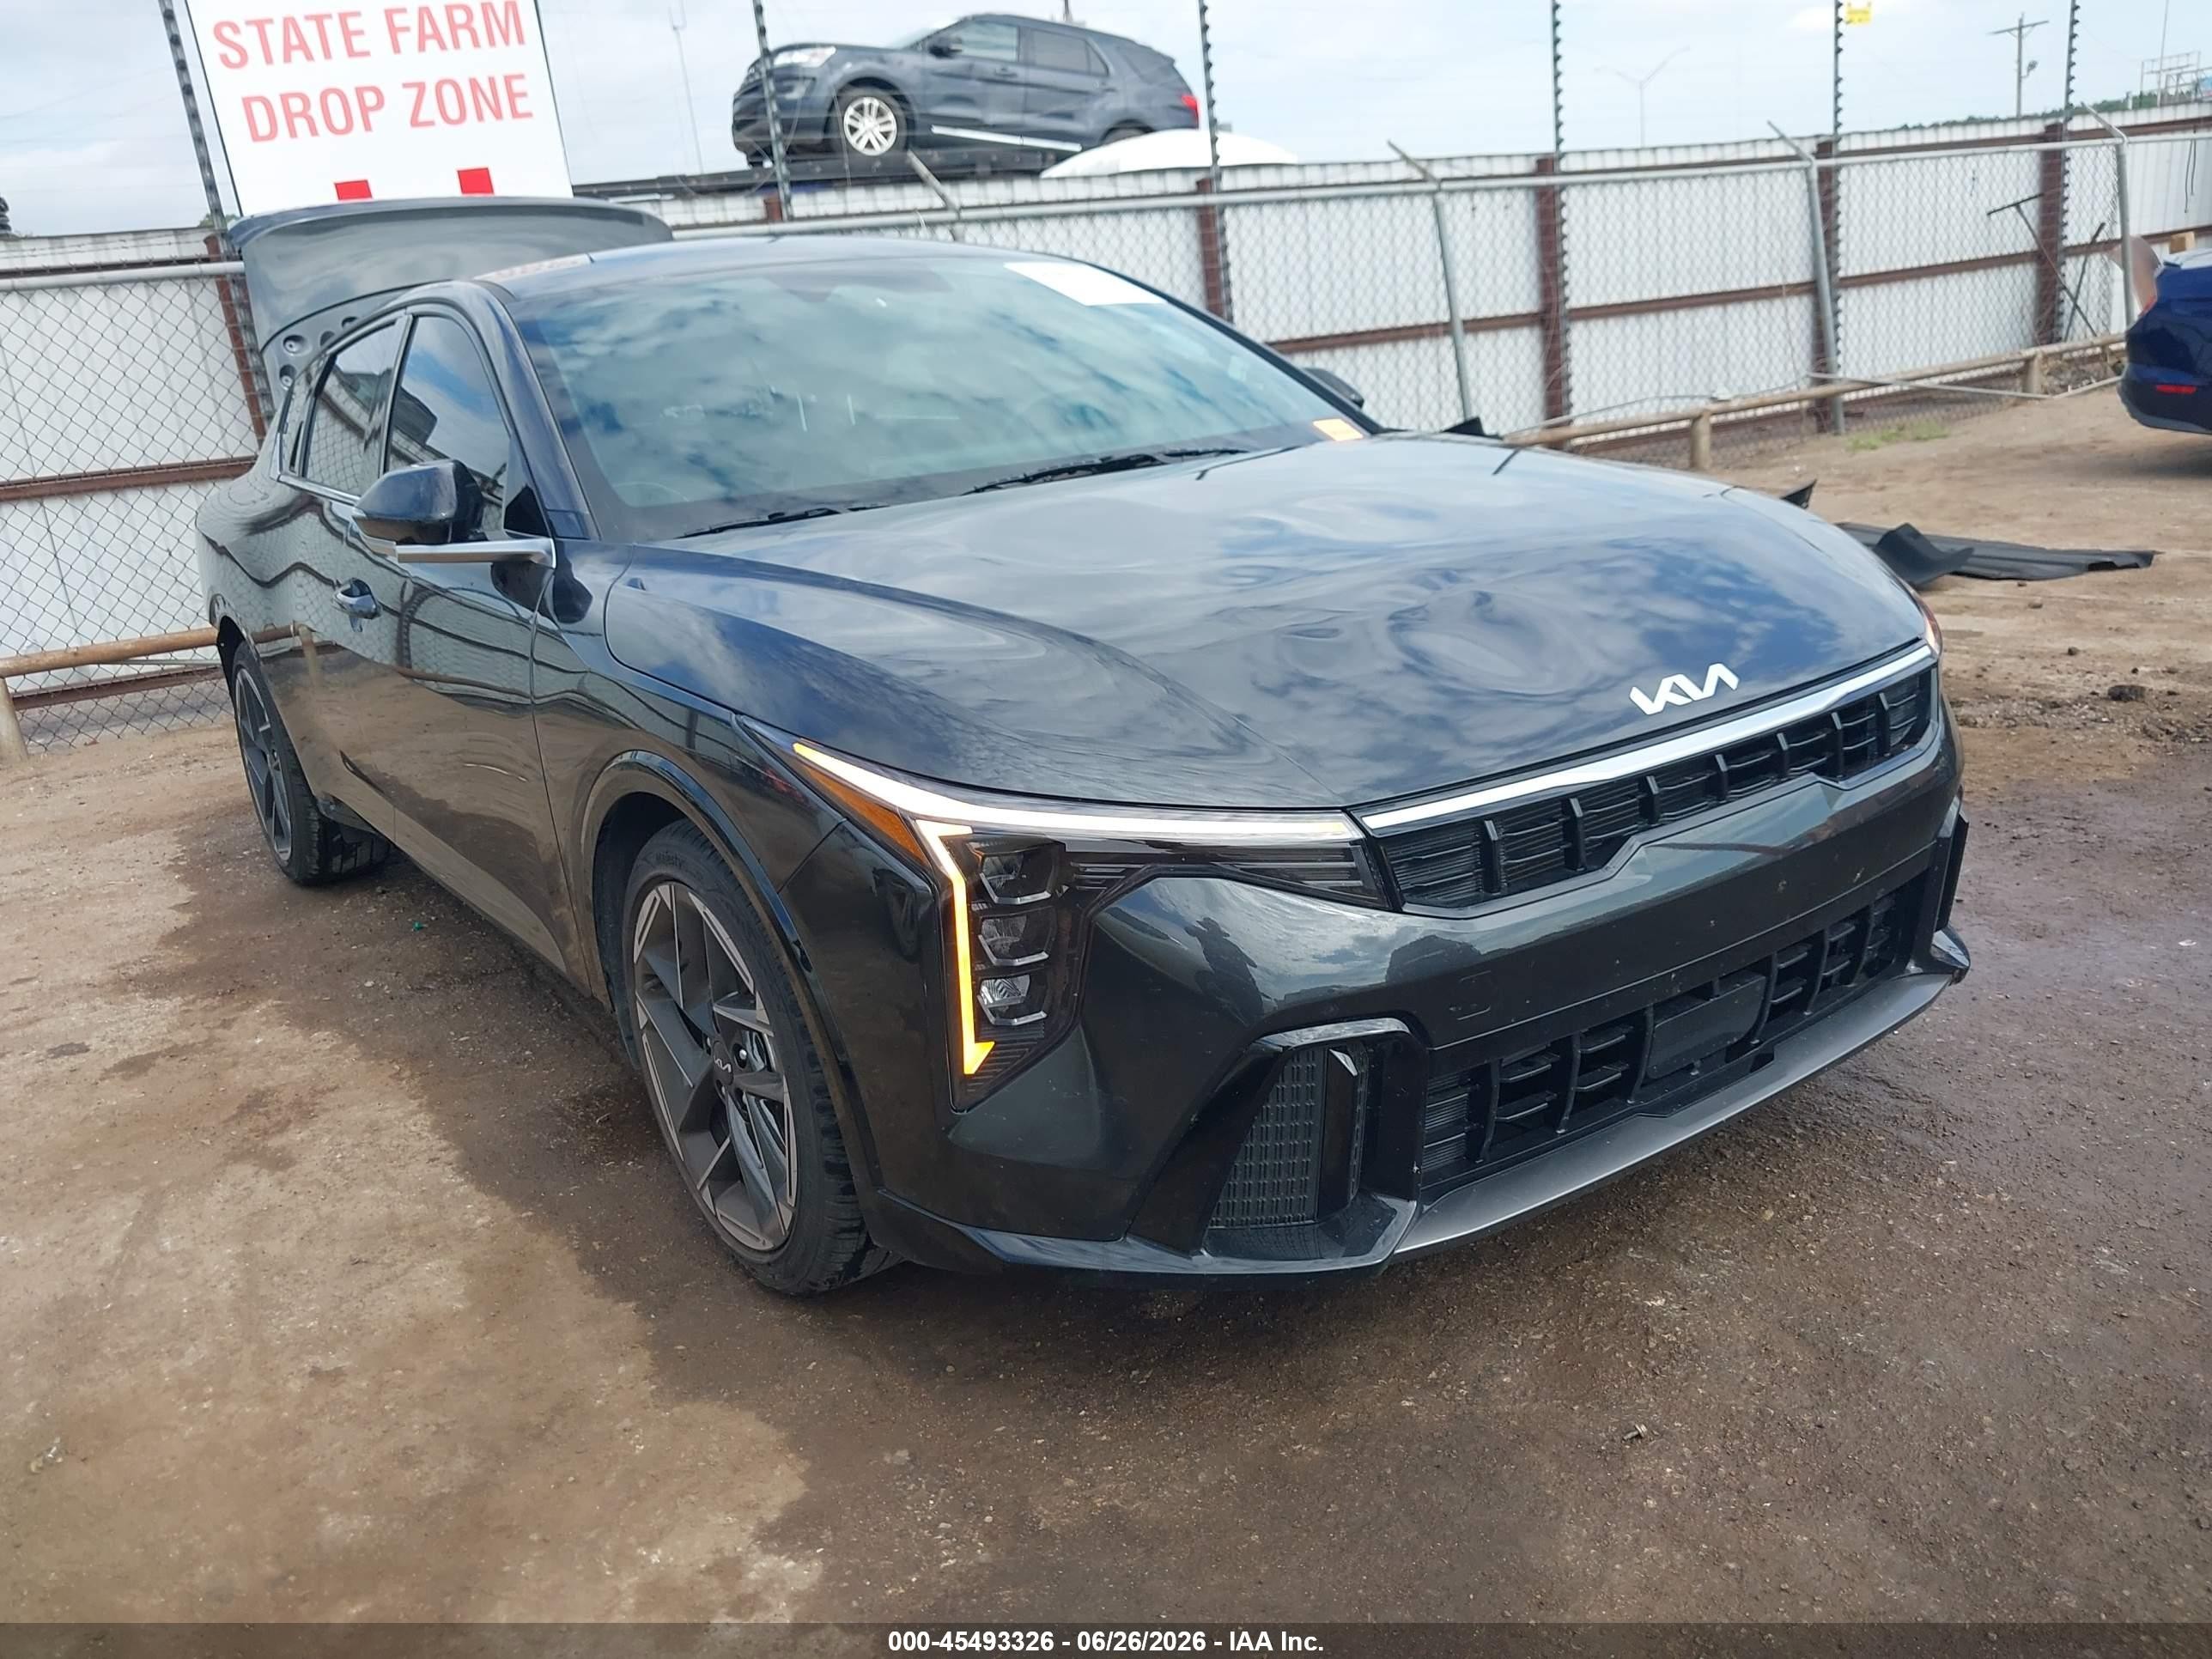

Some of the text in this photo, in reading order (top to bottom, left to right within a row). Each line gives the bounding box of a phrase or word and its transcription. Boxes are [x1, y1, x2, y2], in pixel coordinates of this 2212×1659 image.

[213, 0, 526, 70] STATE FARM
[241, 74, 533, 143] DROP ZONE
[1630, 663, 1740, 715] KIA
